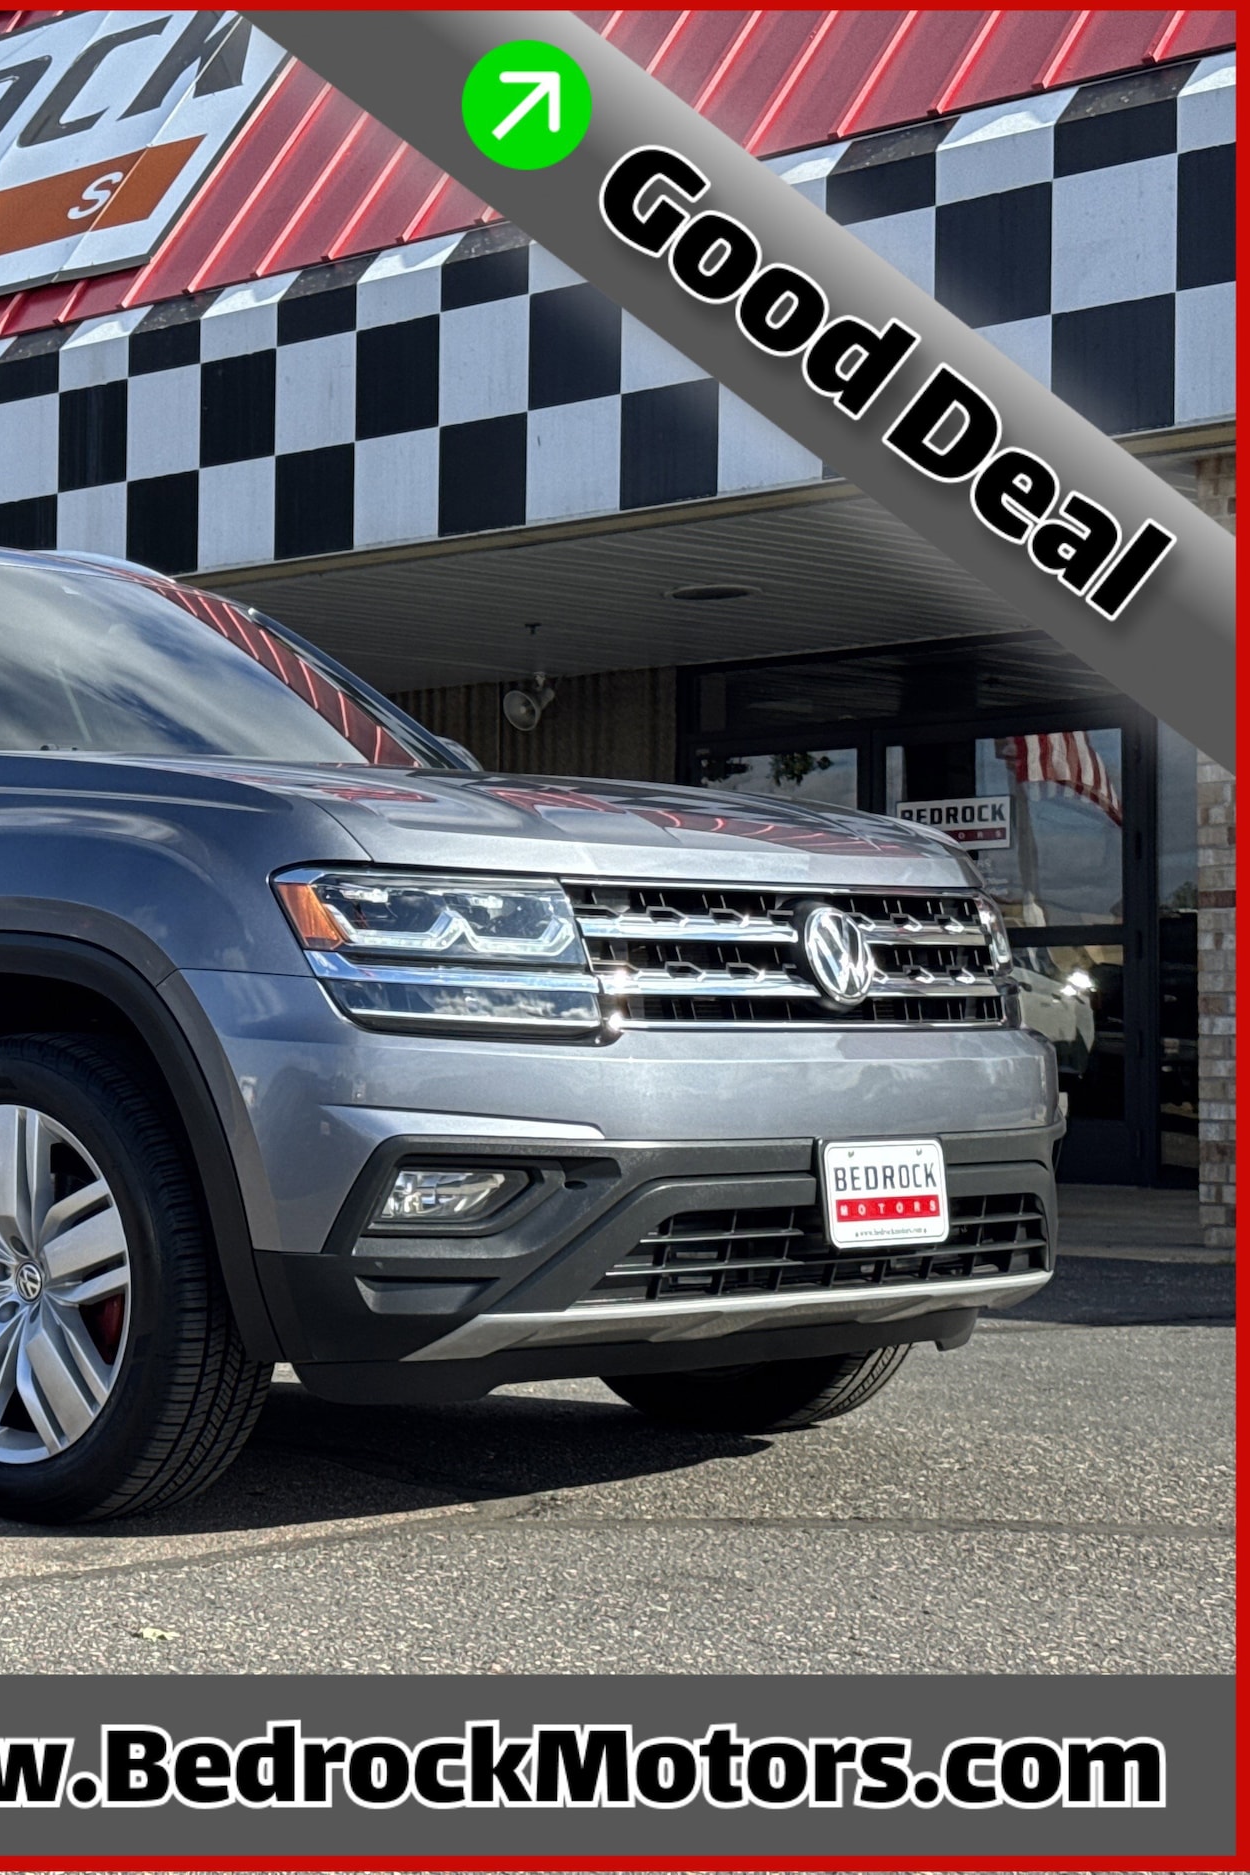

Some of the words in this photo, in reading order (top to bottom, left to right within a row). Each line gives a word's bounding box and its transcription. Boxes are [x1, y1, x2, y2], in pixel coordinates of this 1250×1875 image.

[900, 803, 1006, 825] BEDROCK
[957, 830, 1002, 840] ORS
[834, 1162, 937, 1192] BEDROCK
[840, 1200, 937, 1217] MOTORS
